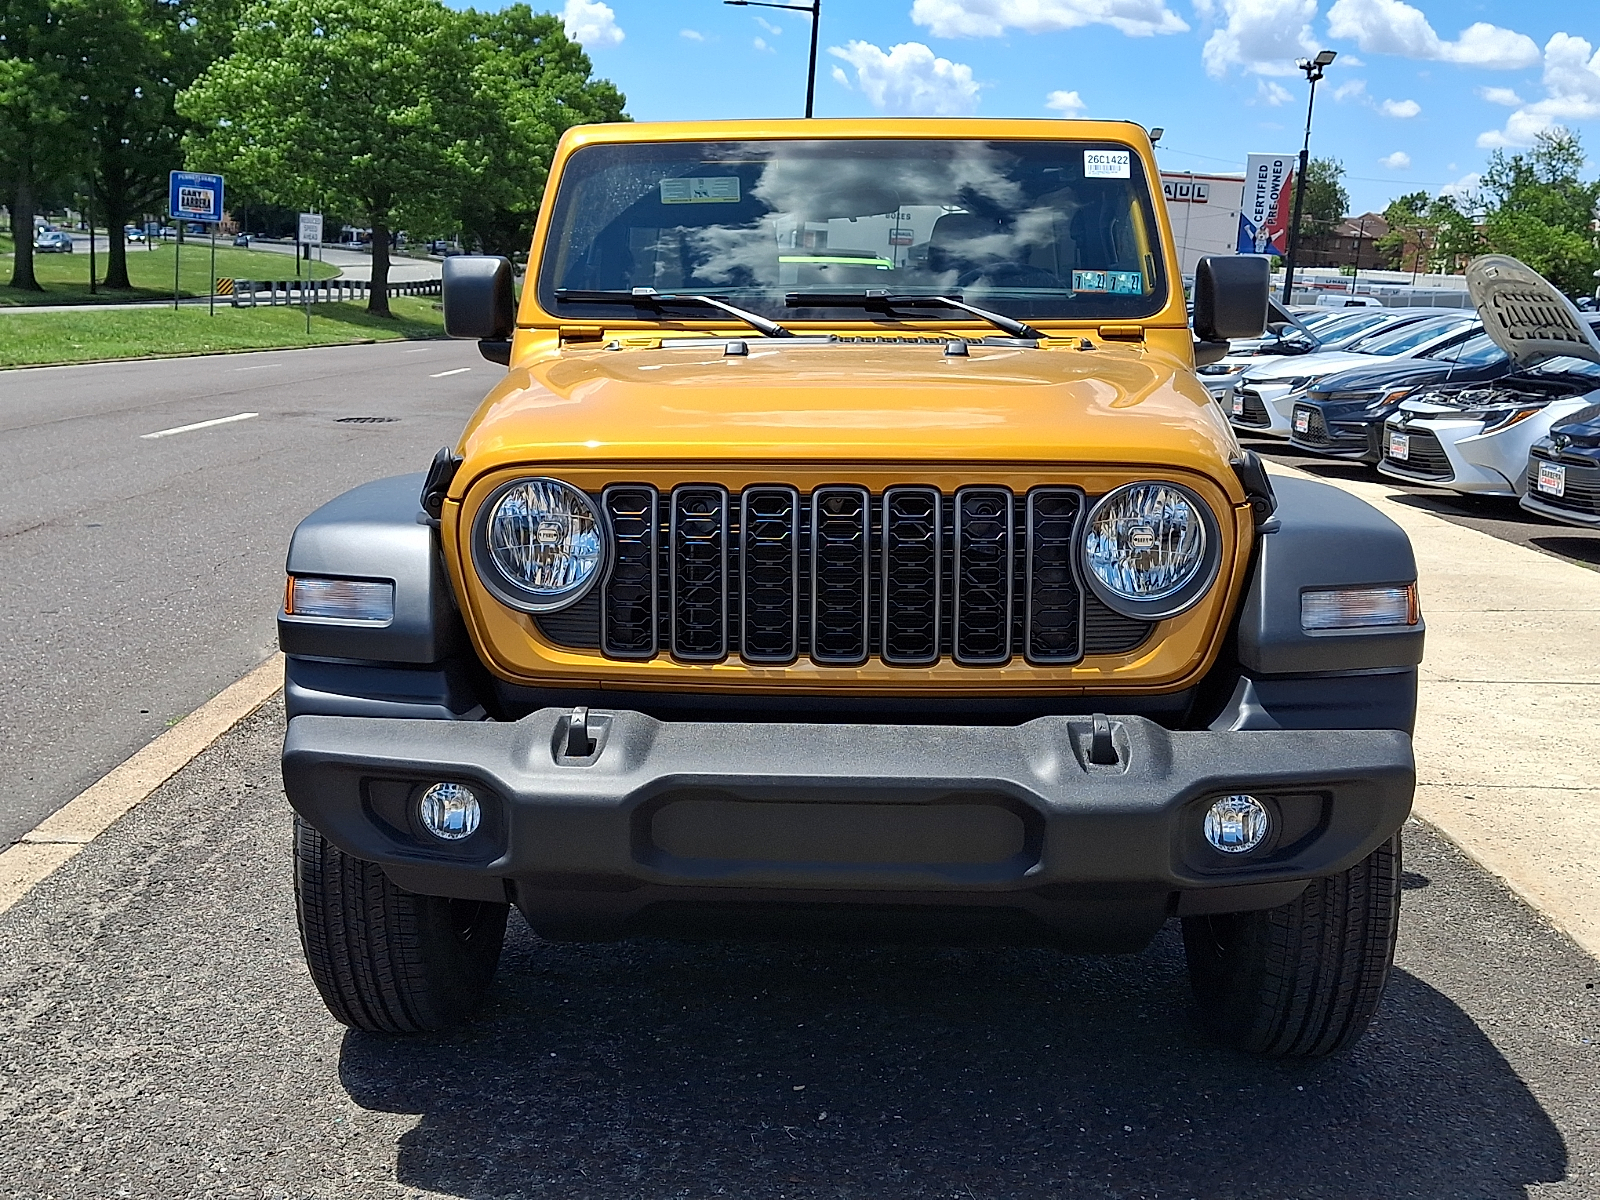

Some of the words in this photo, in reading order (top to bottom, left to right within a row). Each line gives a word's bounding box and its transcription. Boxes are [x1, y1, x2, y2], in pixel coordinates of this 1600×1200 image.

[1088, 155, 1128, 164] 26C1422
[1254, 164, 1268, 222] CERTIFIED
[1268, 159, 1283, 225] PRE-OWNED
[301, 216, 320, 224] REDUCED
